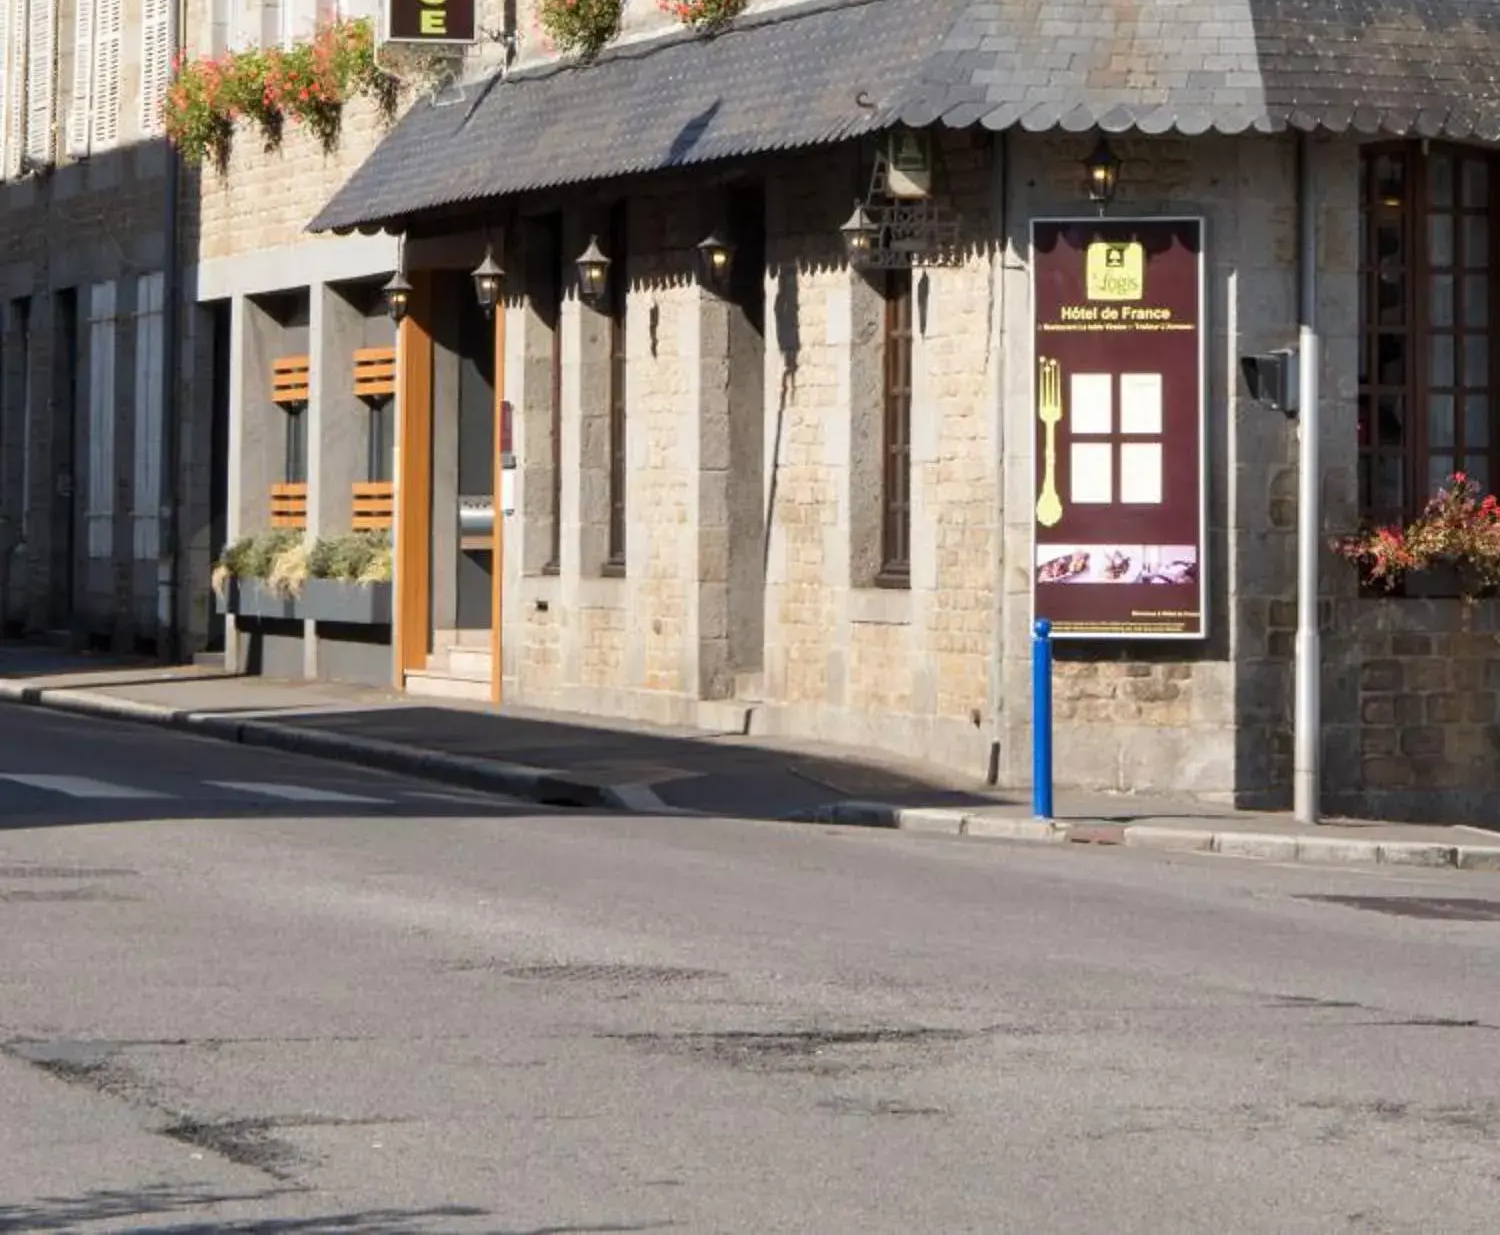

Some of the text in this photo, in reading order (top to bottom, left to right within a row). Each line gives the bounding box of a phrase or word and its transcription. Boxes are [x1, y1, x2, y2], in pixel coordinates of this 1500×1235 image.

[1061, 306, 1171, 321] Hôtel de France
